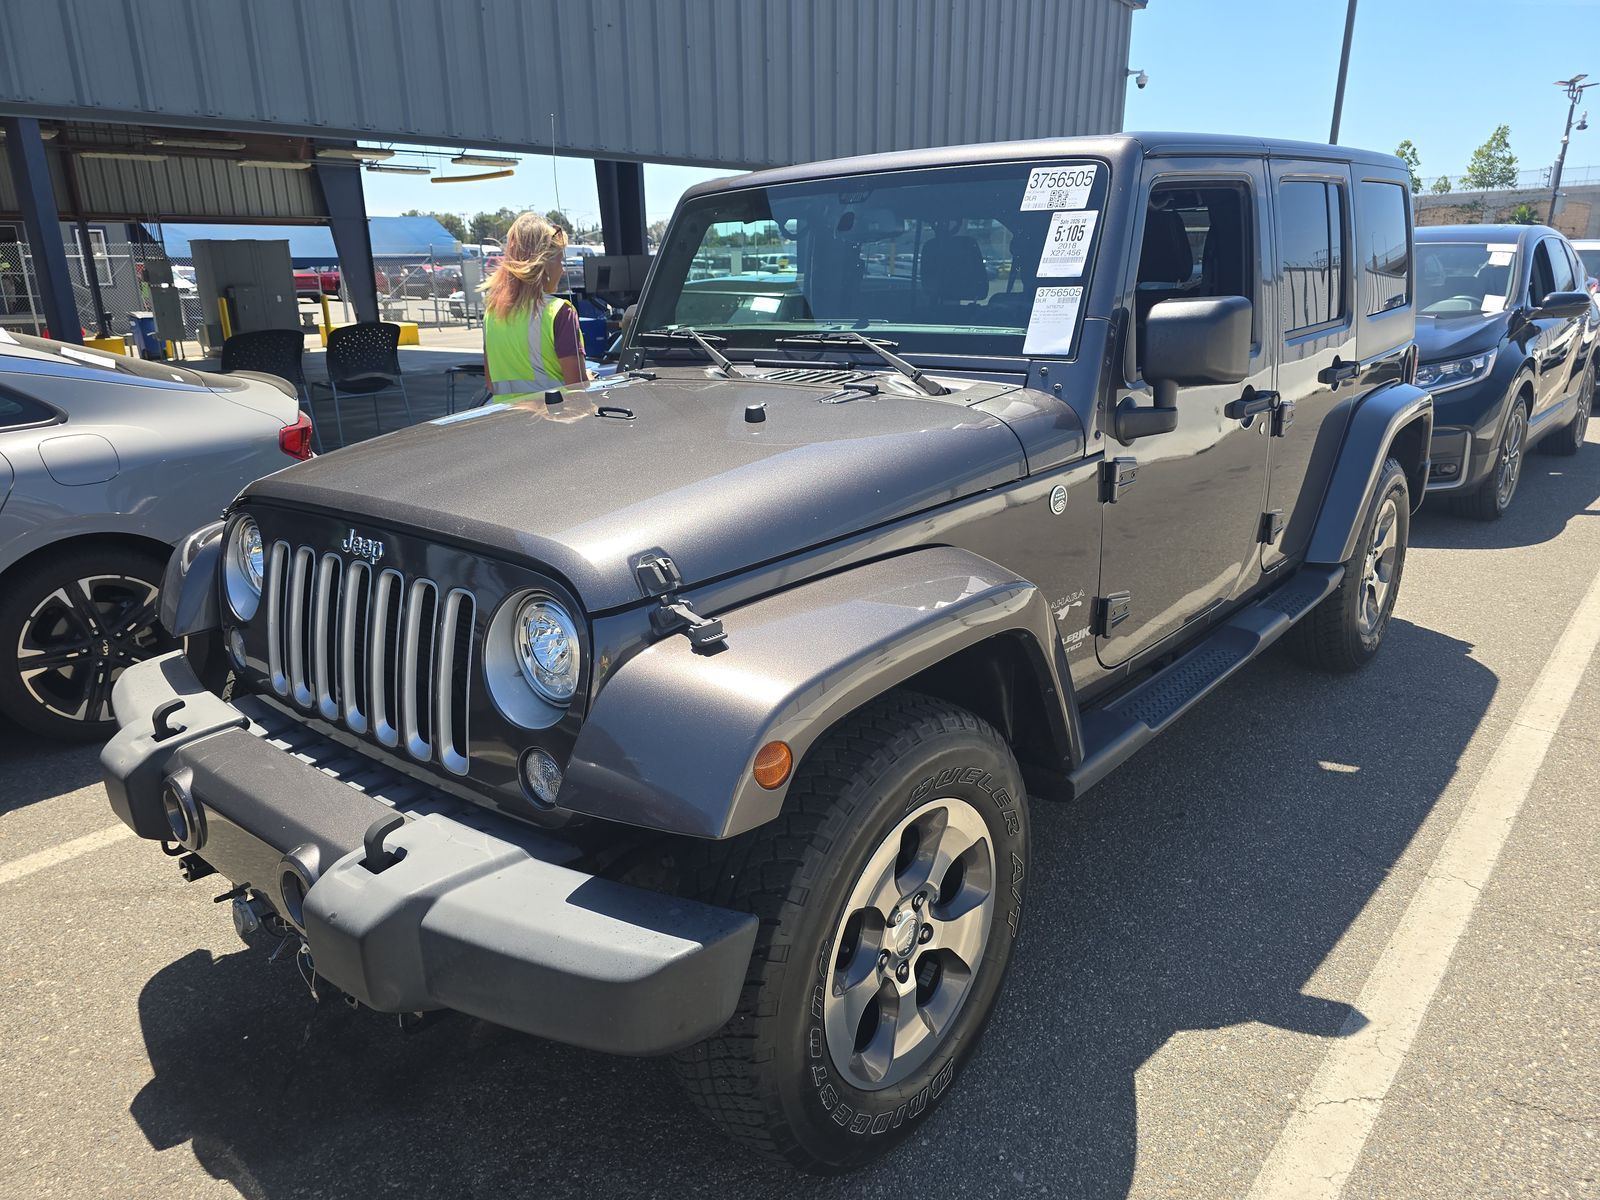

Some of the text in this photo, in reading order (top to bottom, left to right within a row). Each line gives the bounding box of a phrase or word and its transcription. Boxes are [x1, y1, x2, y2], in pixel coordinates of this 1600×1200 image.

[1029, 170, 1095, 189] 3756505
[1054, 224, 1086, 242] 5:105
[1057, 242, 1077, 250] 2018
[1038, 287, 1082, 298] 3756505
[341, 528, 385, 565] Jeep
[1051, 588, 1086, 609] AHARA
[905, 766, 1021, 837] DUELER
